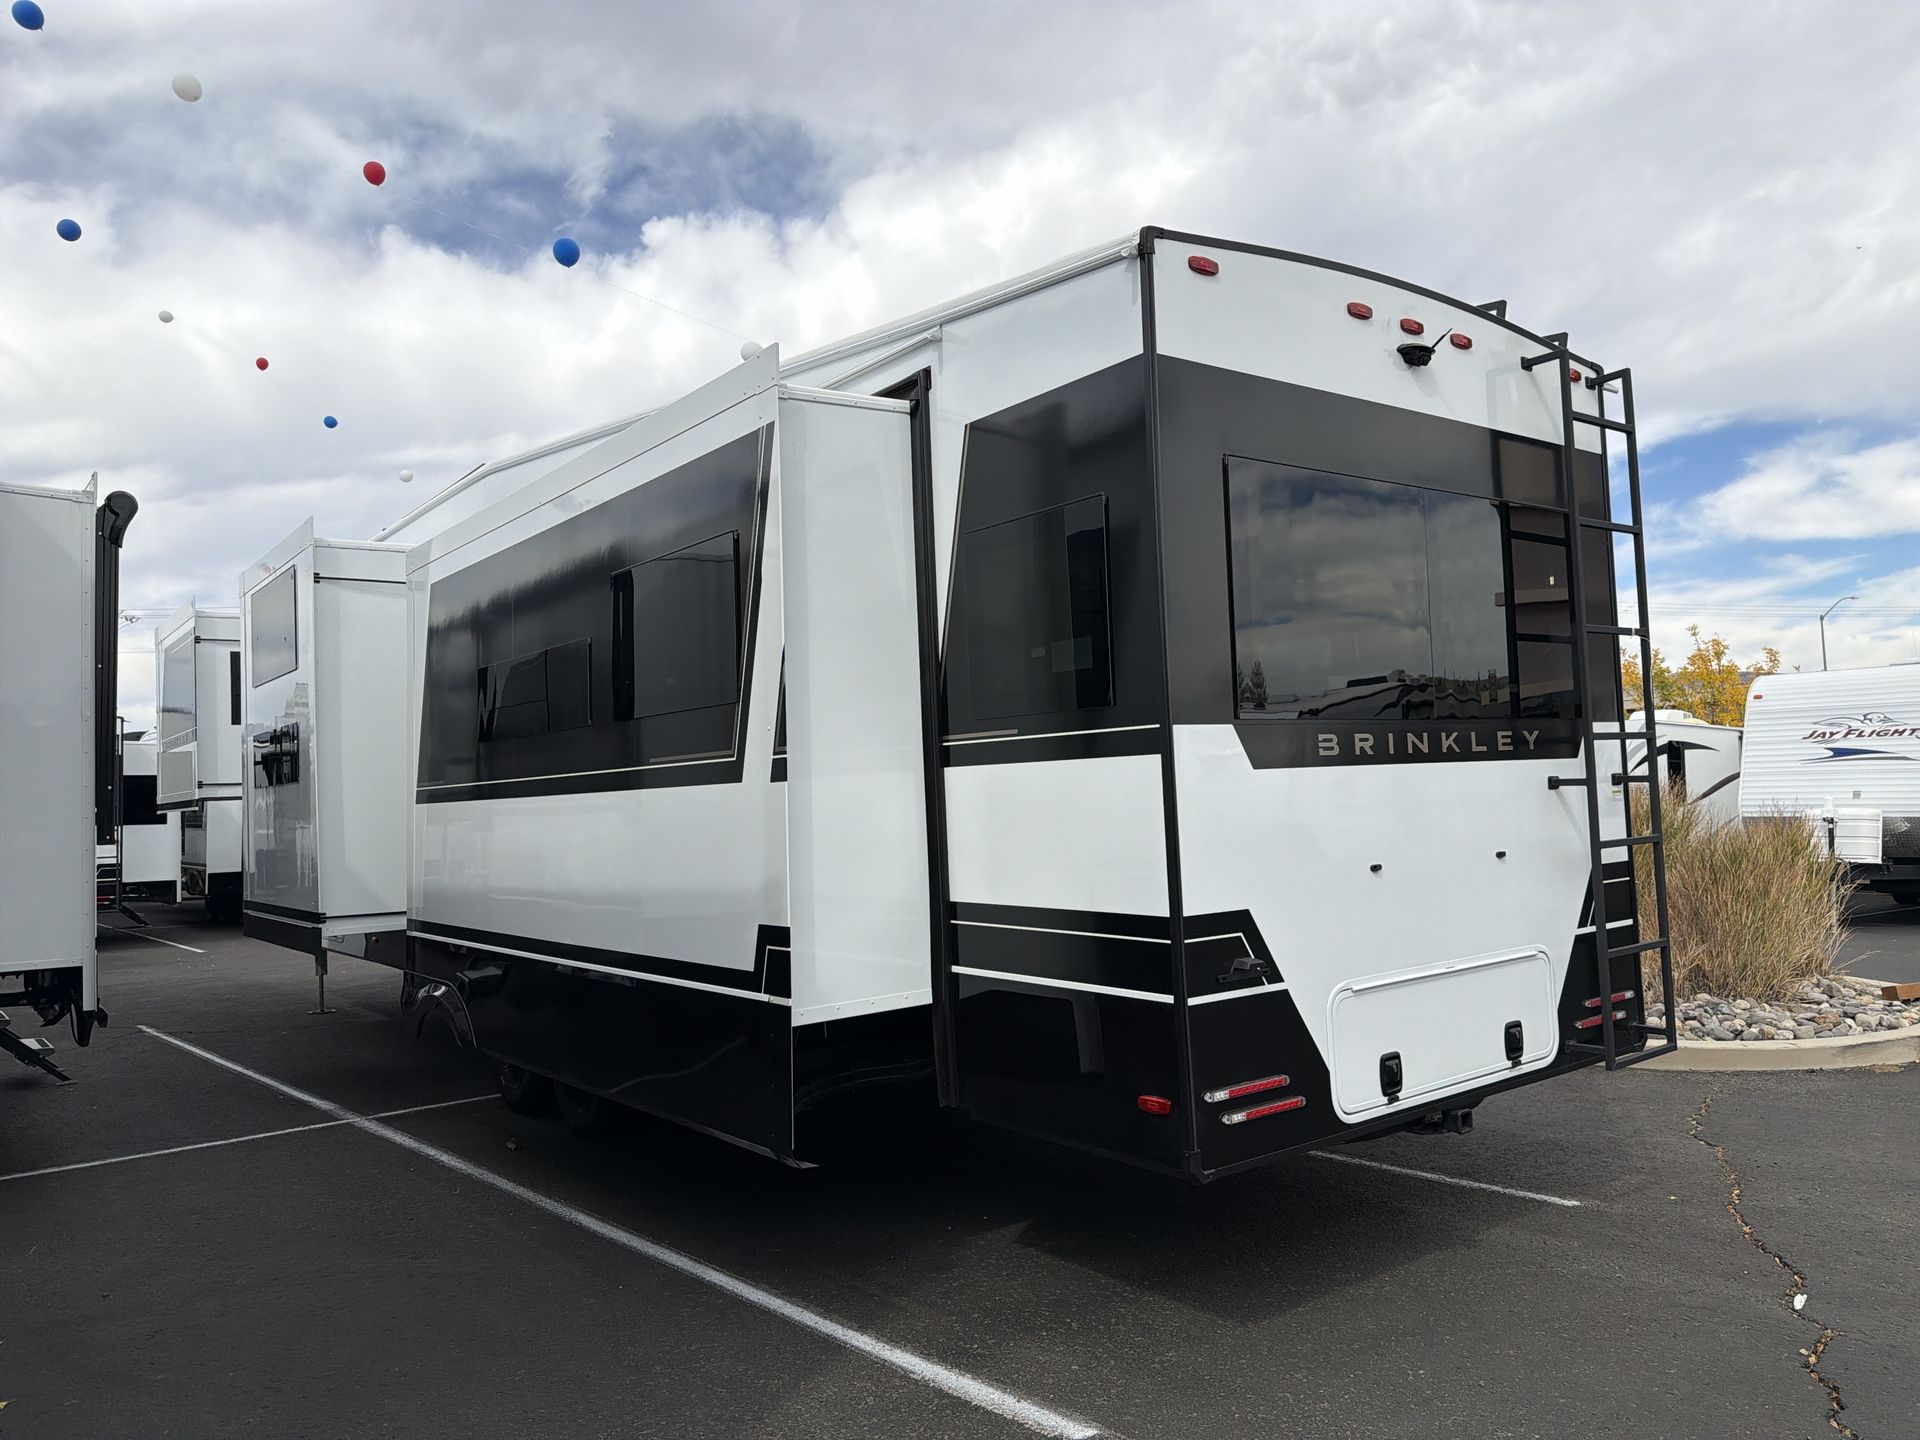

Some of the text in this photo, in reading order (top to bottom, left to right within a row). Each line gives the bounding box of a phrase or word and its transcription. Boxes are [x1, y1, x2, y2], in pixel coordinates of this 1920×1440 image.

[1317, 730, 1539, 756] BRINKLEY
[1801, 727, 1920, 740] JAY FLIGHT
